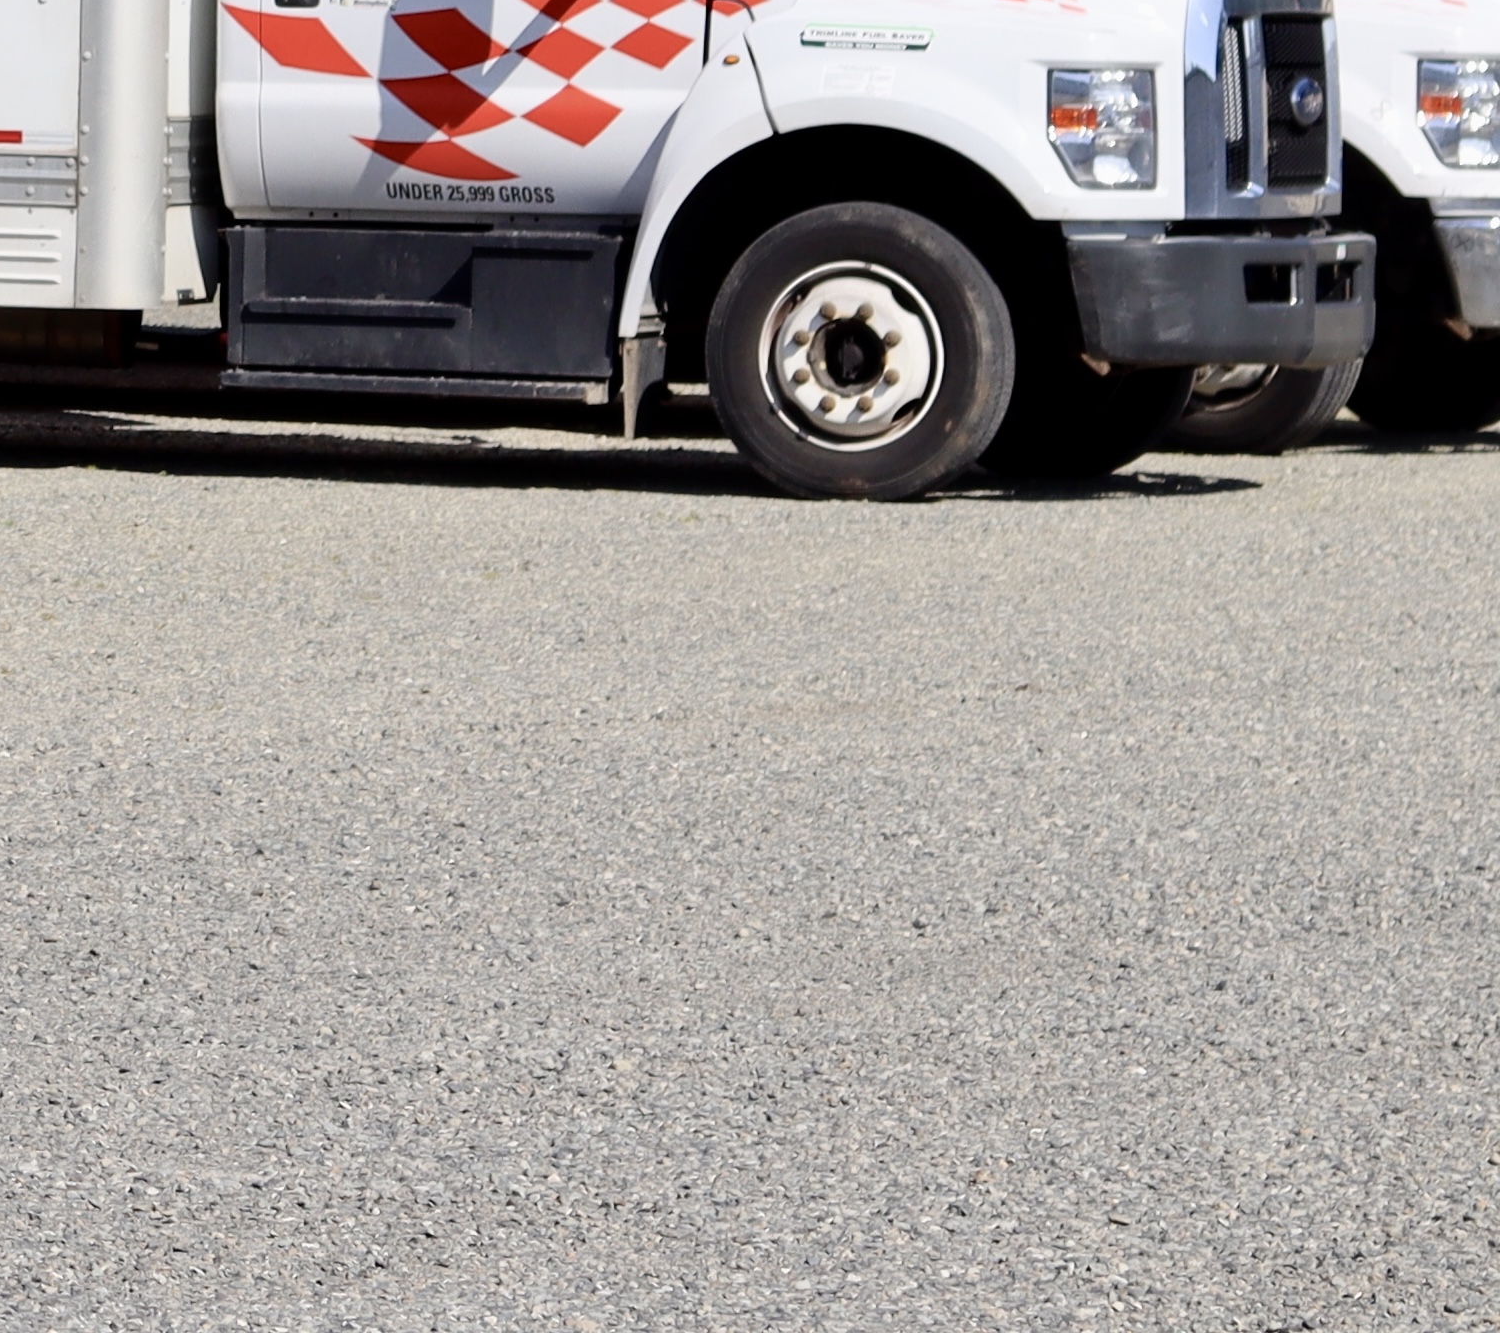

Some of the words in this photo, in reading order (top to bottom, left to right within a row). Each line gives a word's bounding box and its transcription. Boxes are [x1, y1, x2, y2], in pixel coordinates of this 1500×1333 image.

[386, 181, 444, 203] UNDER
[446, 183, 496, 206] 25,999
[499, 185, 555, 205] GROSS
